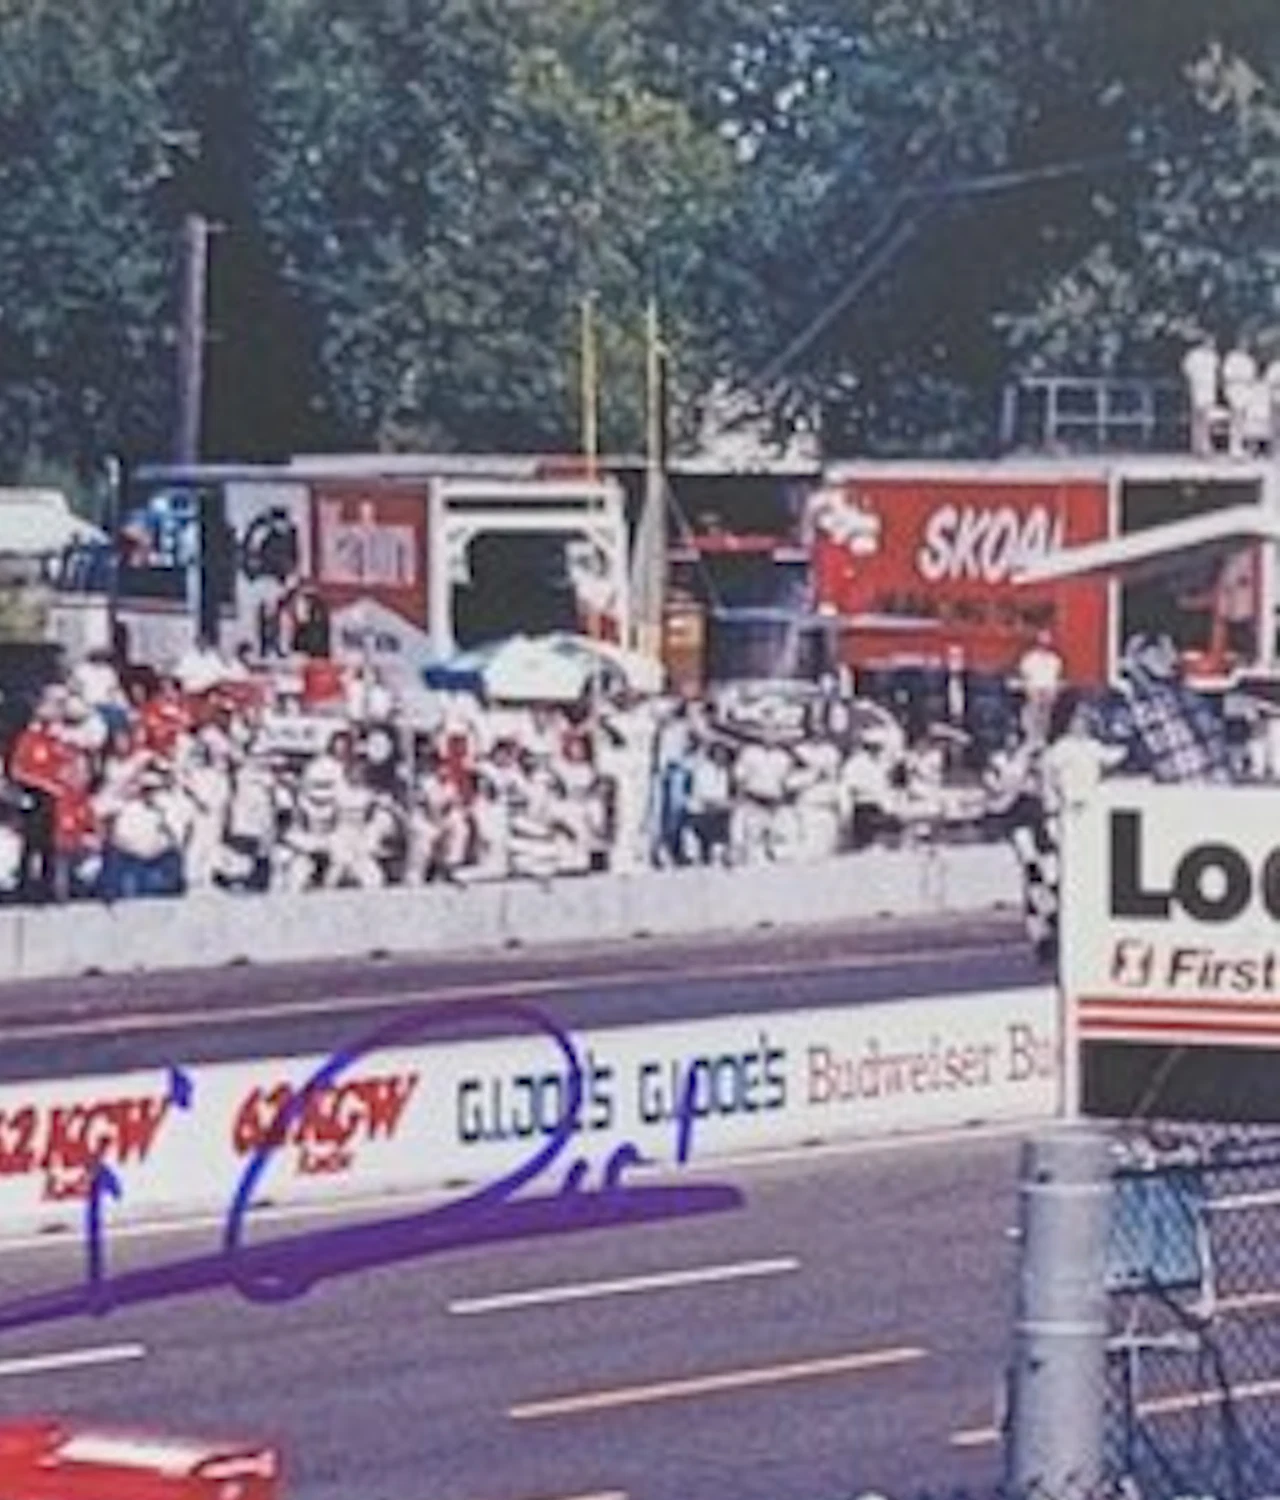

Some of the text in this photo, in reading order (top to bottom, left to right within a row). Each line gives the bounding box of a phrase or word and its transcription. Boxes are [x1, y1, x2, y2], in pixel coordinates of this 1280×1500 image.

[1110, 808, 1280, 924] Lo
[1165, 946, 1276, 993] First
[807, 1035, 997, 1104] Budweiser
[40, 1095, 173, 1170] KGW
[232, 1072, 420, 1156] 62 KGW
